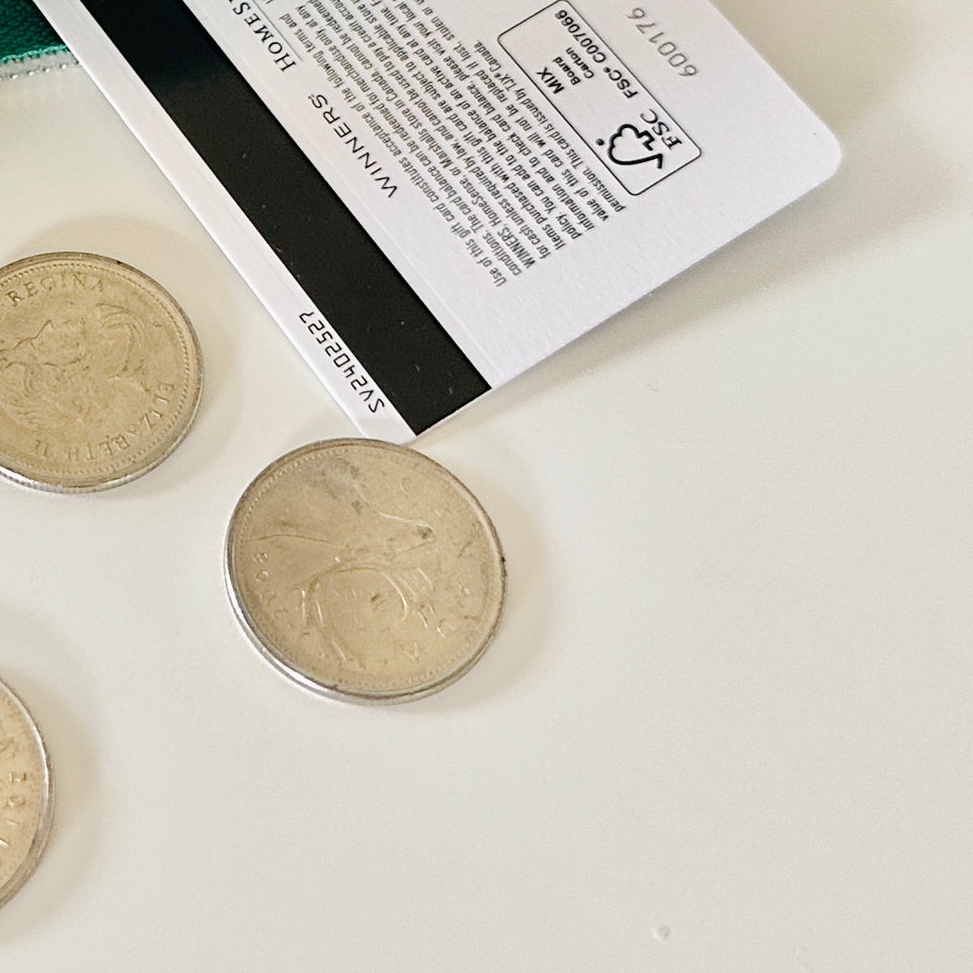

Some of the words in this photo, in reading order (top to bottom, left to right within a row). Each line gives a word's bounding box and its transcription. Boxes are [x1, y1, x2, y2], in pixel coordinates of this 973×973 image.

[277, 12, 299, 30] and
[294, 3, 312, 21] any
[356, 3, 379, 25] store
[393, 0, 418, 24] local
[420, 5, 435, 17] or
[304, 17, 320, 30] at
[347, 19, 373, 44] credit
[395, 23, 413, 40] any
[412, 20, 434, 40] your
[429, 15, 456, 42] stolen
[293, 27, 317, 54] terms
[338, 31, 353, 47] be
[366, 40, 378, 49] a
[372, 22, 410, 63] applicable
[405, 37, 420, 50] at
[426, 37, 447, 57] visit
[554, 8, 608, 65] C007066
[624, 5, 702, 78] 600176
[345, 42, 374, 71] cannot
[371, 46, 392, 64] pay
[411, 47, 435, 67] card
[464, 60, 480, 71] if
[564, 46, 596, 80] Carton
[311, 49, 346, 90] following
[327, 44, 372, 94] merchandise
[382, 60, 396, 73] to
[404, 60, 418, 73] to
[429, 64, 455, 90] active
[442, 55, 471, 83] please
[551, 55, 582, 87] Board
[387, 68, 412, 91] used
[410, 69, 442, 101] subject
[471, 68, 509, 104] replaced
[535, 65, 566, 95] MIX
[340, 86, 358, 104] the
[365, 91, 381, 107] for
[393, 98, 407, 111] in
[405, 87, 421, 103] be
[449, 87, 464, 102] an
[454, 99, 472, 111] of
[512, 87, 528, 102] by
[349, 100, 367, 113] of
[412, 97, 443, 127] cannot
[436, 99, 454, 115] are
[504, 103, 520, 119] be
[517, 97, 550, 127] issued
[372, 101, 413, 143] redeemed
[400, 107, 424, 131] store
[444, 112, 469, 133] card
[466, 108, 498, 144] balance
[488, 112, 513, 133] card
[513, 115, 534, 133] not
[542, 122, 556, 135] is
[639, 108, 684, 151] FSC
[361, 111, 403, 158] acceptance
[432, 123, 455, 142] and
[461, 130, 484, 148] gift
[526, 131, 547, 149] will
[546, 130, 571, 151] card
[405, 139, 421, 155] be
[417, 127, 455, 170] Marshalls
[492, 139, 510, 157] the
[505, 131, 533, 157] check
[414, 149, 433, 168] can
[461, 155, 477, 171] by
[475, 145, 495, 166] this
[504, 153, 518, 167] to
[528, 155, 542, 169] to
[540, 148, 565, 169] card
[564, 147, 585, 171] This
[397, 155, 441, 204] constitutes
[426, 164, 458, 200] balance
[448, 165, 463, 178] or
[489, 162, 511, 184] with
[509, 163, 532, 182] add
[533, 166, 556, 185] and
[560, 167, 580, 188] this
[467, 165, 504, 201] required
[526, 179, 545, 198] can
[572, 186, 590, 199] of
[431, 201, 456, 223] card
[448, 194, 473, 217] card
[497, 197, 526, 227] unless
[502, 181, 549, 226] purchased
[539, 195, 558, 216] You
[551, 182, 596, 233] information
[585, 197, 610, 223] value
[449, 220, 473, 240] gift
[466, 213, 486, 235] The
[517, 223, 542, 247] cash
[540, 223, 567, 252] Items
[464, 237, 485, 259] this
[535, 243, 553, 260] for
[475, 255, 494, 269] of
[488, 266, 508, 288] Use
[5, 273, 105, 307] REGINA
[298, 311, 386, 414] SV2402527
